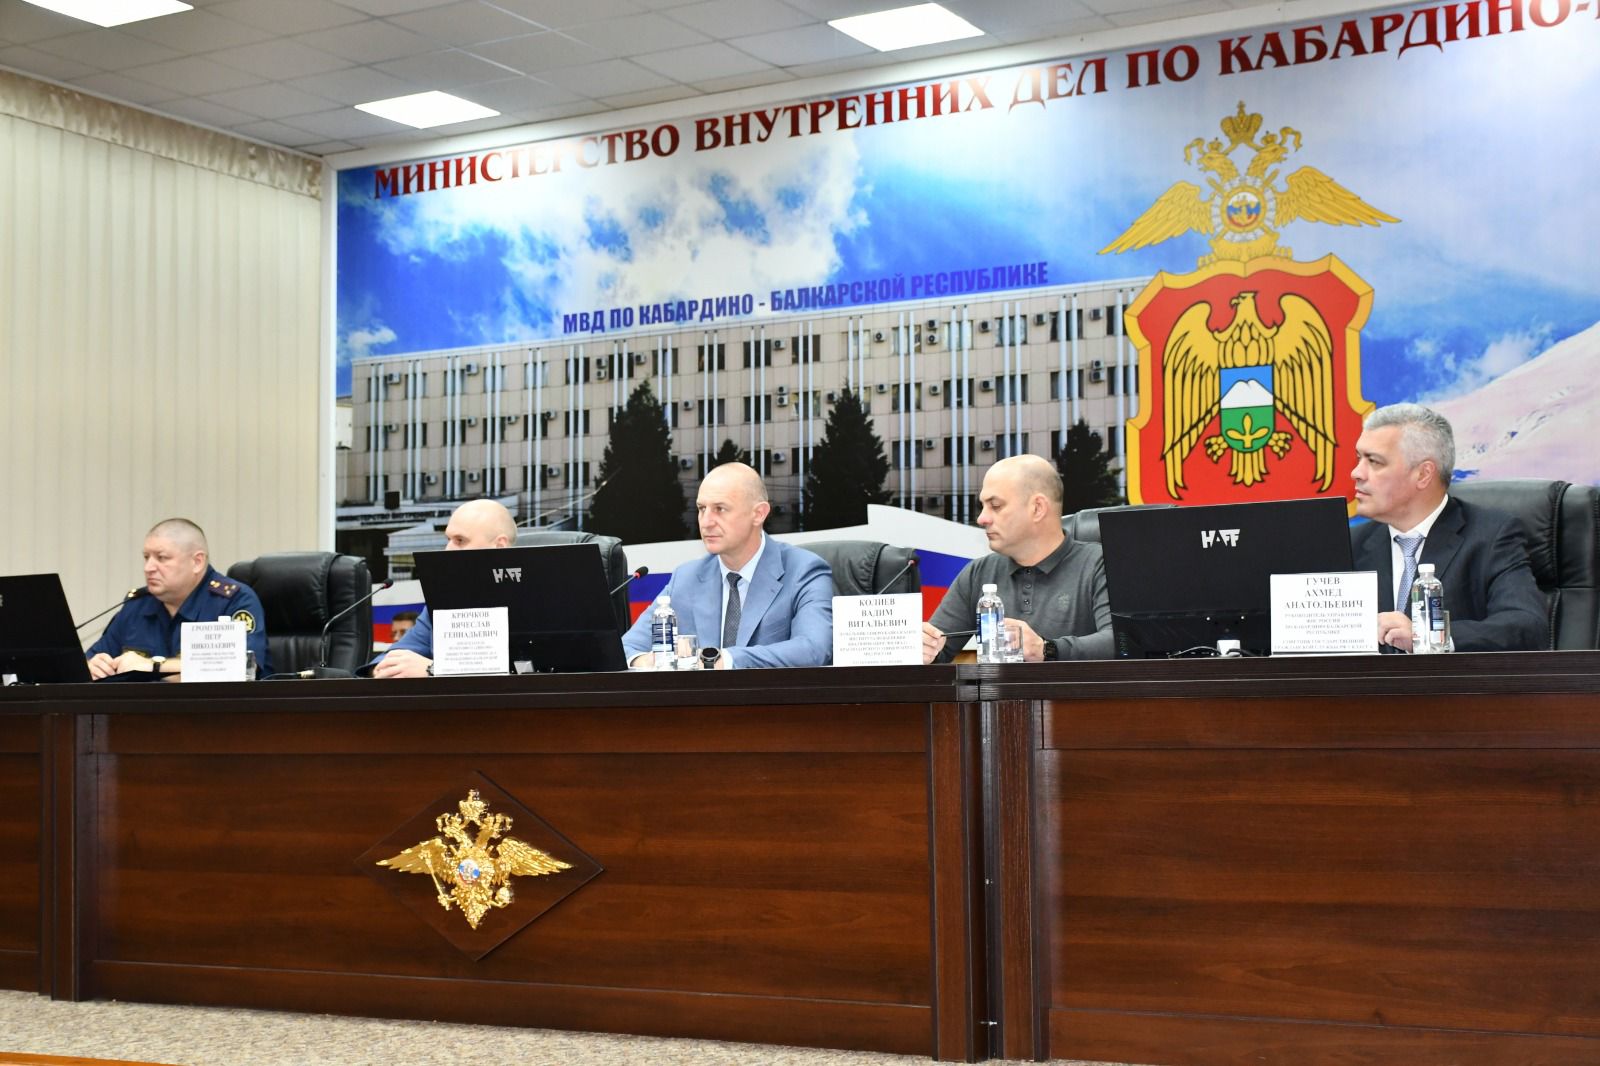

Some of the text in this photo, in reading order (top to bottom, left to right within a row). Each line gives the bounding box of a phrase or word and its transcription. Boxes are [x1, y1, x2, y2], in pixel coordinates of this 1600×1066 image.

[374, 0, 1600, 200] МИНИСТЕРСТВО ВНУТРЕННИХ ДЕЛ ПО КАБАРДИНО-
[563, 311, 605, 335] МВД
[610, 308, 634, 329] ПО
[639, 293, 754, 326] КАБАРДИНО
[770, 273, 901, 312] БАЛКАРСКОЙ
[910, 261, 1049, 297] РЕСПУБЛИКЕ
[1306, 576, 1340, 585] ГУЧЕВ
[1305, 588, 1342, 598] АХМЕД
[1284, 599, 1363, 609] АНАТОЛЬЕВИЧ
[451, 611, 490, 619] КРЮЧКОВ
[861, 608, 893, 617] ВАДИМ
[451, 620, 491, 629] ВЯЧЕСЛАВ
[848, 619, 907, 628] ВИТАЛЬЕВИЧ
[443, 630, 498, 639] ГЕННАДЬЕВИЧ
